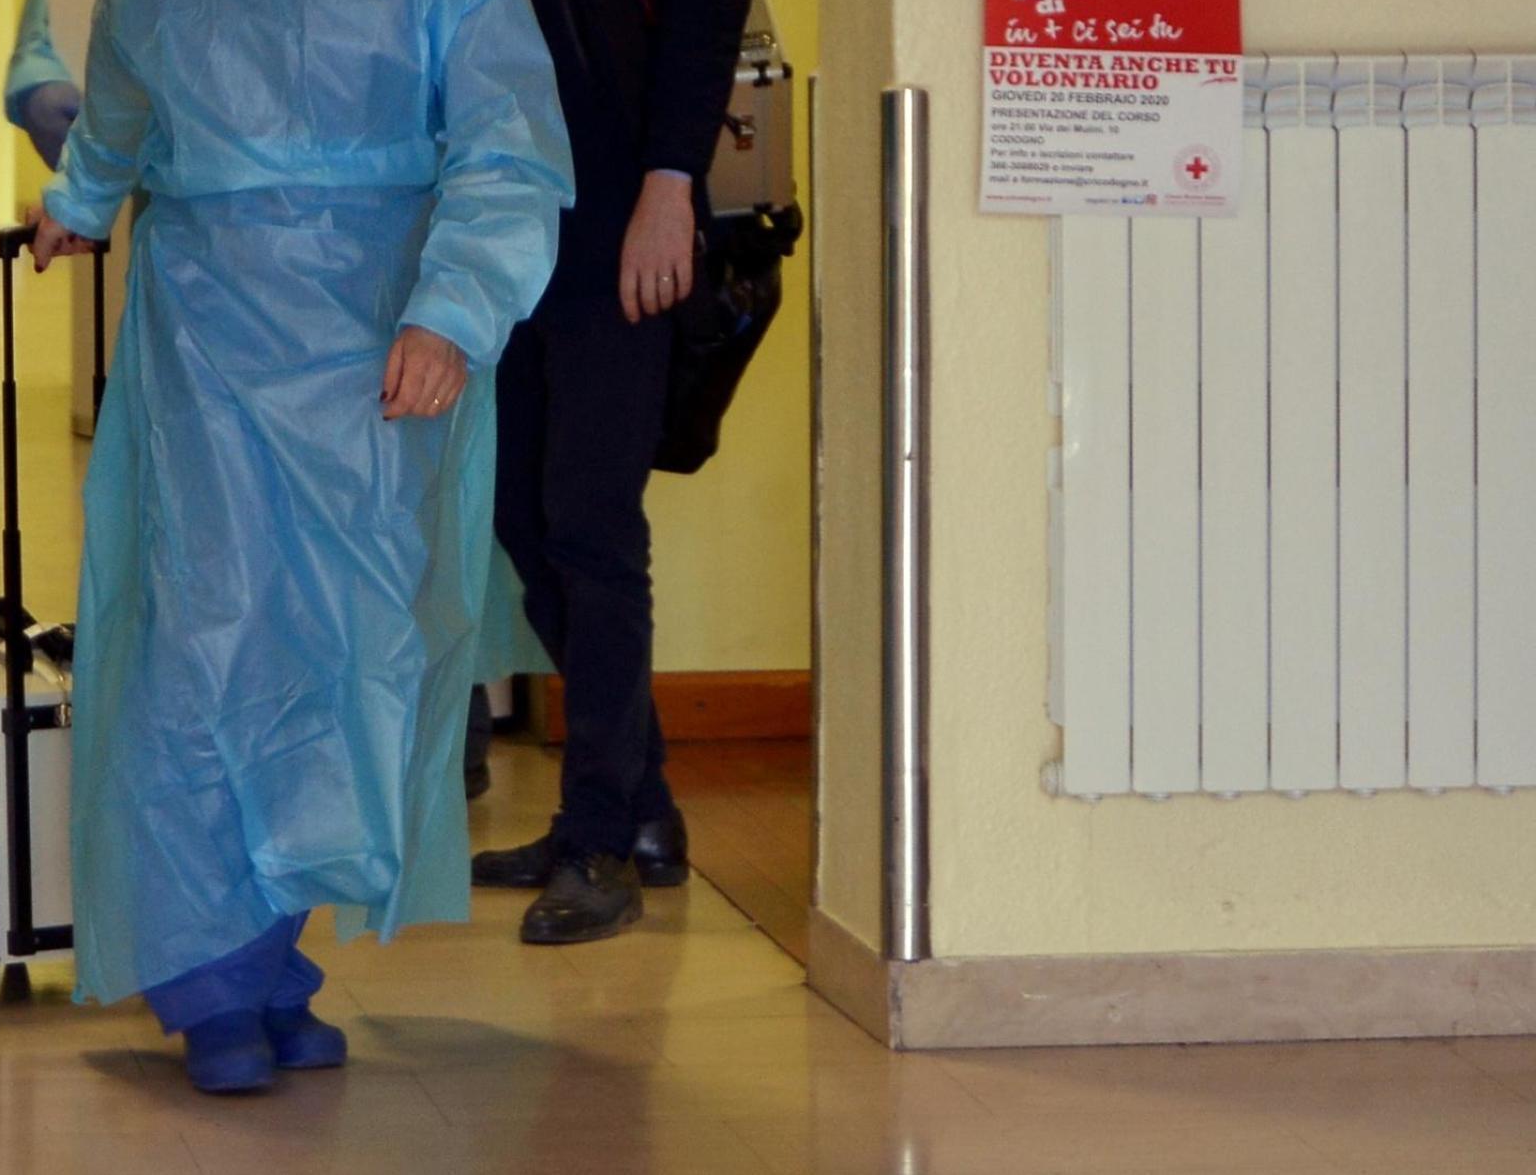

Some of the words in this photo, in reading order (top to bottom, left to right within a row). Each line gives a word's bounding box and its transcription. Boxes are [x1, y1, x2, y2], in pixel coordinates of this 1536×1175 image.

[1072, 18, 1099, 42] ci
[1105, 19, 1145, 43] sei
[990, 51, 1105, 71] DIVENTA
[1110, 55, 1201, 75] ANCHE
[1204, 58, 1238, 75] TU
[989, 69, 1160, 91] VOLONTARIO
[1050, 91, 1066, 103] 20
[1068, 92, 1137, 106] FEBBRAIO
[1140, 93, 1171, 107] 2020
[992, 107, 1088, 122] PRESENTAZIONE
[1092, 109, 1114, 122] DEL
[1118, 110, 1161, 124] CORSO
[991, 134, 1045, 145] CODOGNO
